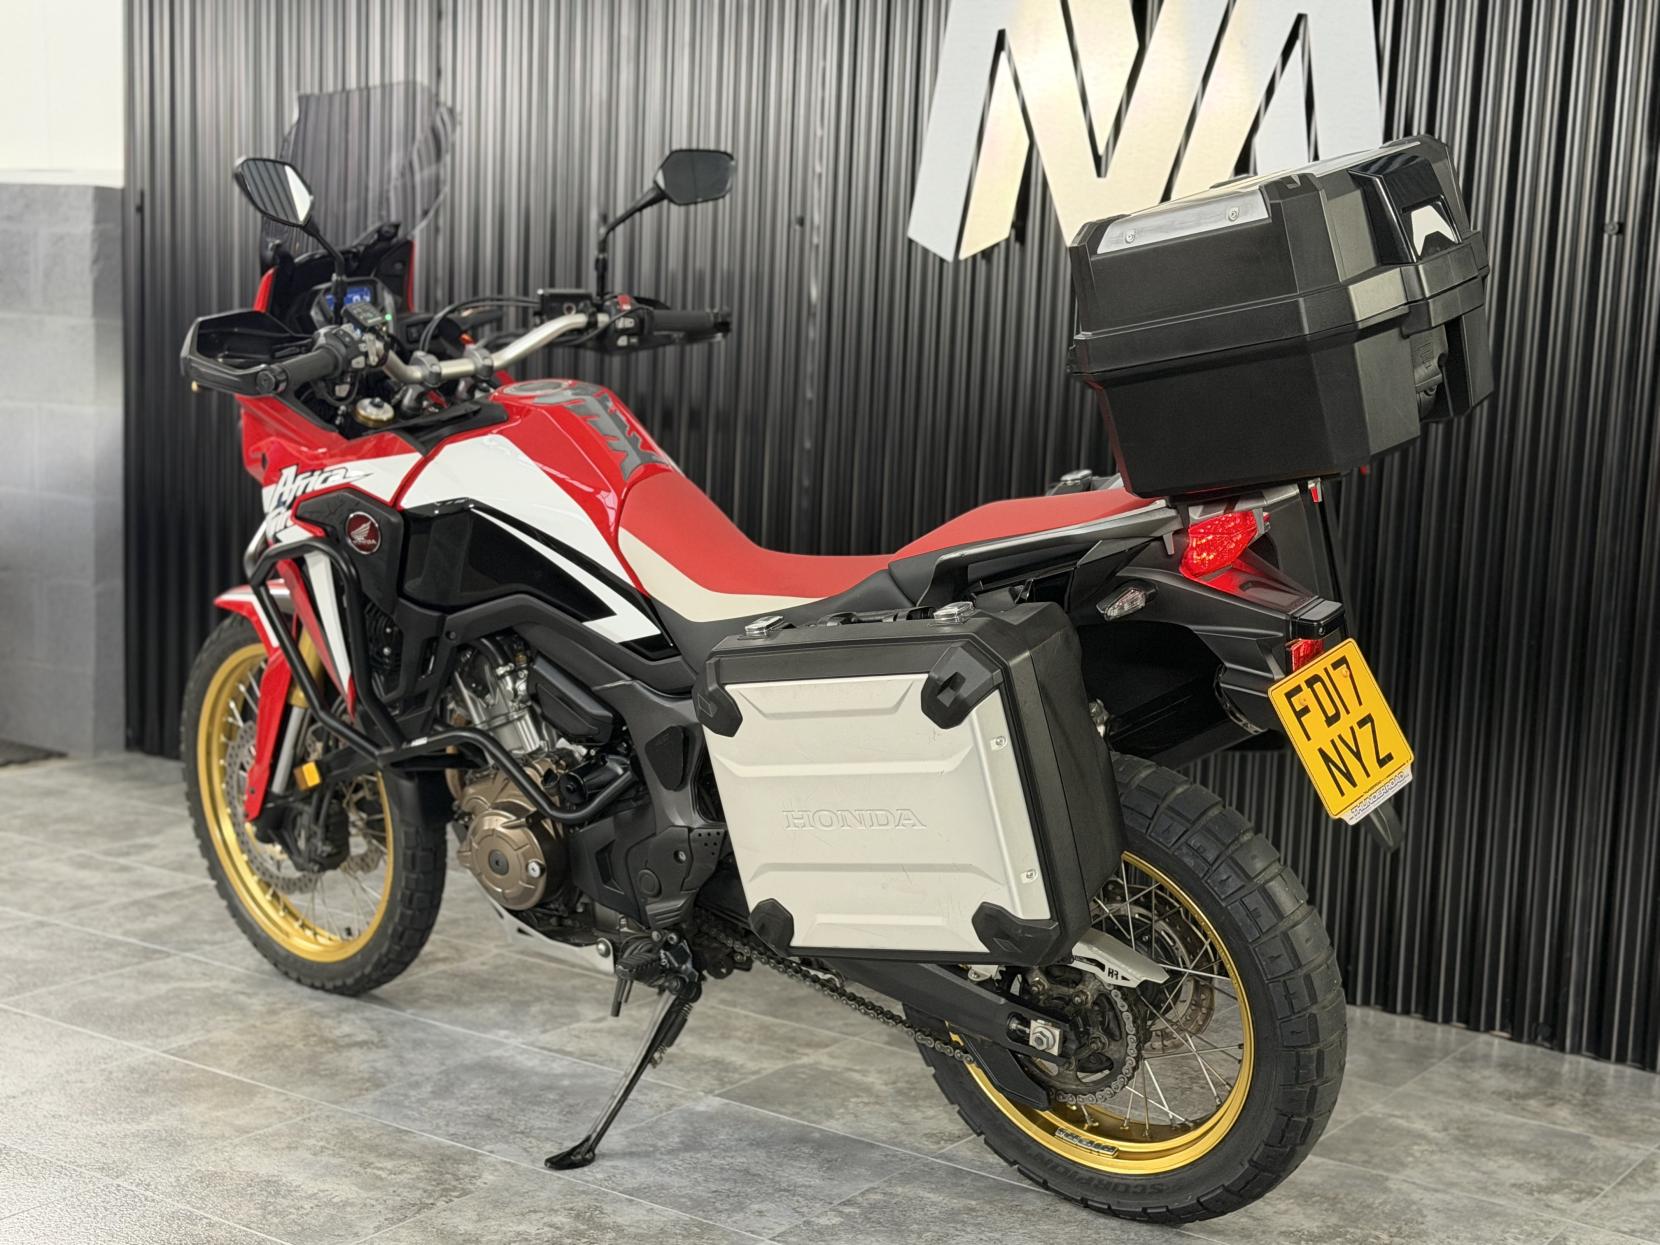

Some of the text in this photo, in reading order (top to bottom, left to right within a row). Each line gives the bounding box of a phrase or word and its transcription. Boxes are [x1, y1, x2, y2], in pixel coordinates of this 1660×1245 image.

[268, 465, 373, 511] Africa
[1284, 655, 1363, 741] FD17
[1317, 713, 1394, 797] NYZ
[782, 808, 927, 832] HONDA
